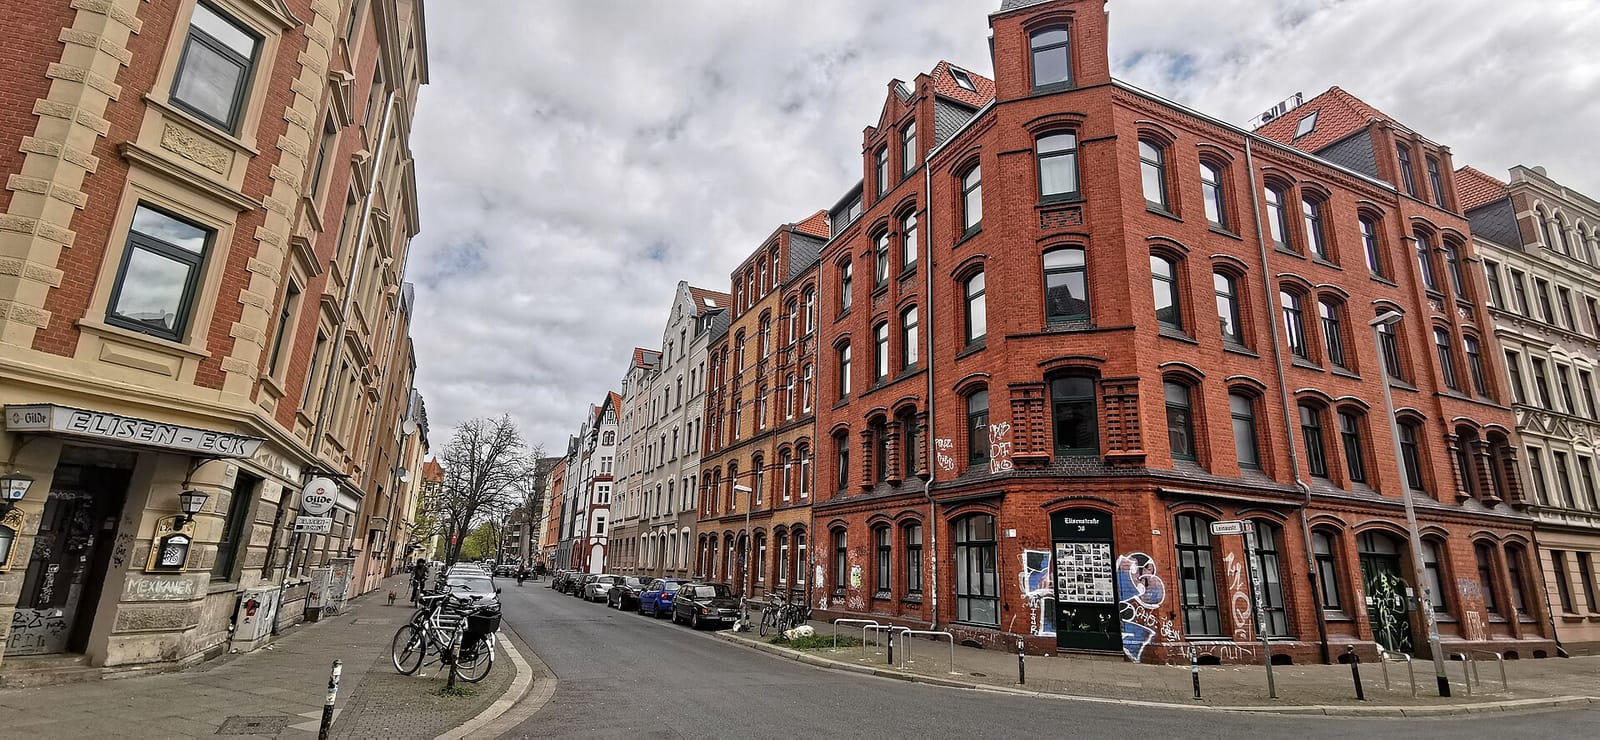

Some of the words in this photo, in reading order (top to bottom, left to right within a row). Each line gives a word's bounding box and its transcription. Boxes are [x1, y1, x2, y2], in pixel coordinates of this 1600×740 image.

[24, 412, 47, 424] Gilde
[66, 411, 178, 445] ELISEN
[197, 432, 250, 455] ECK
[305, 495, 332, 504] Gilde
[127, 578, 194, 595] MEXIKANER
